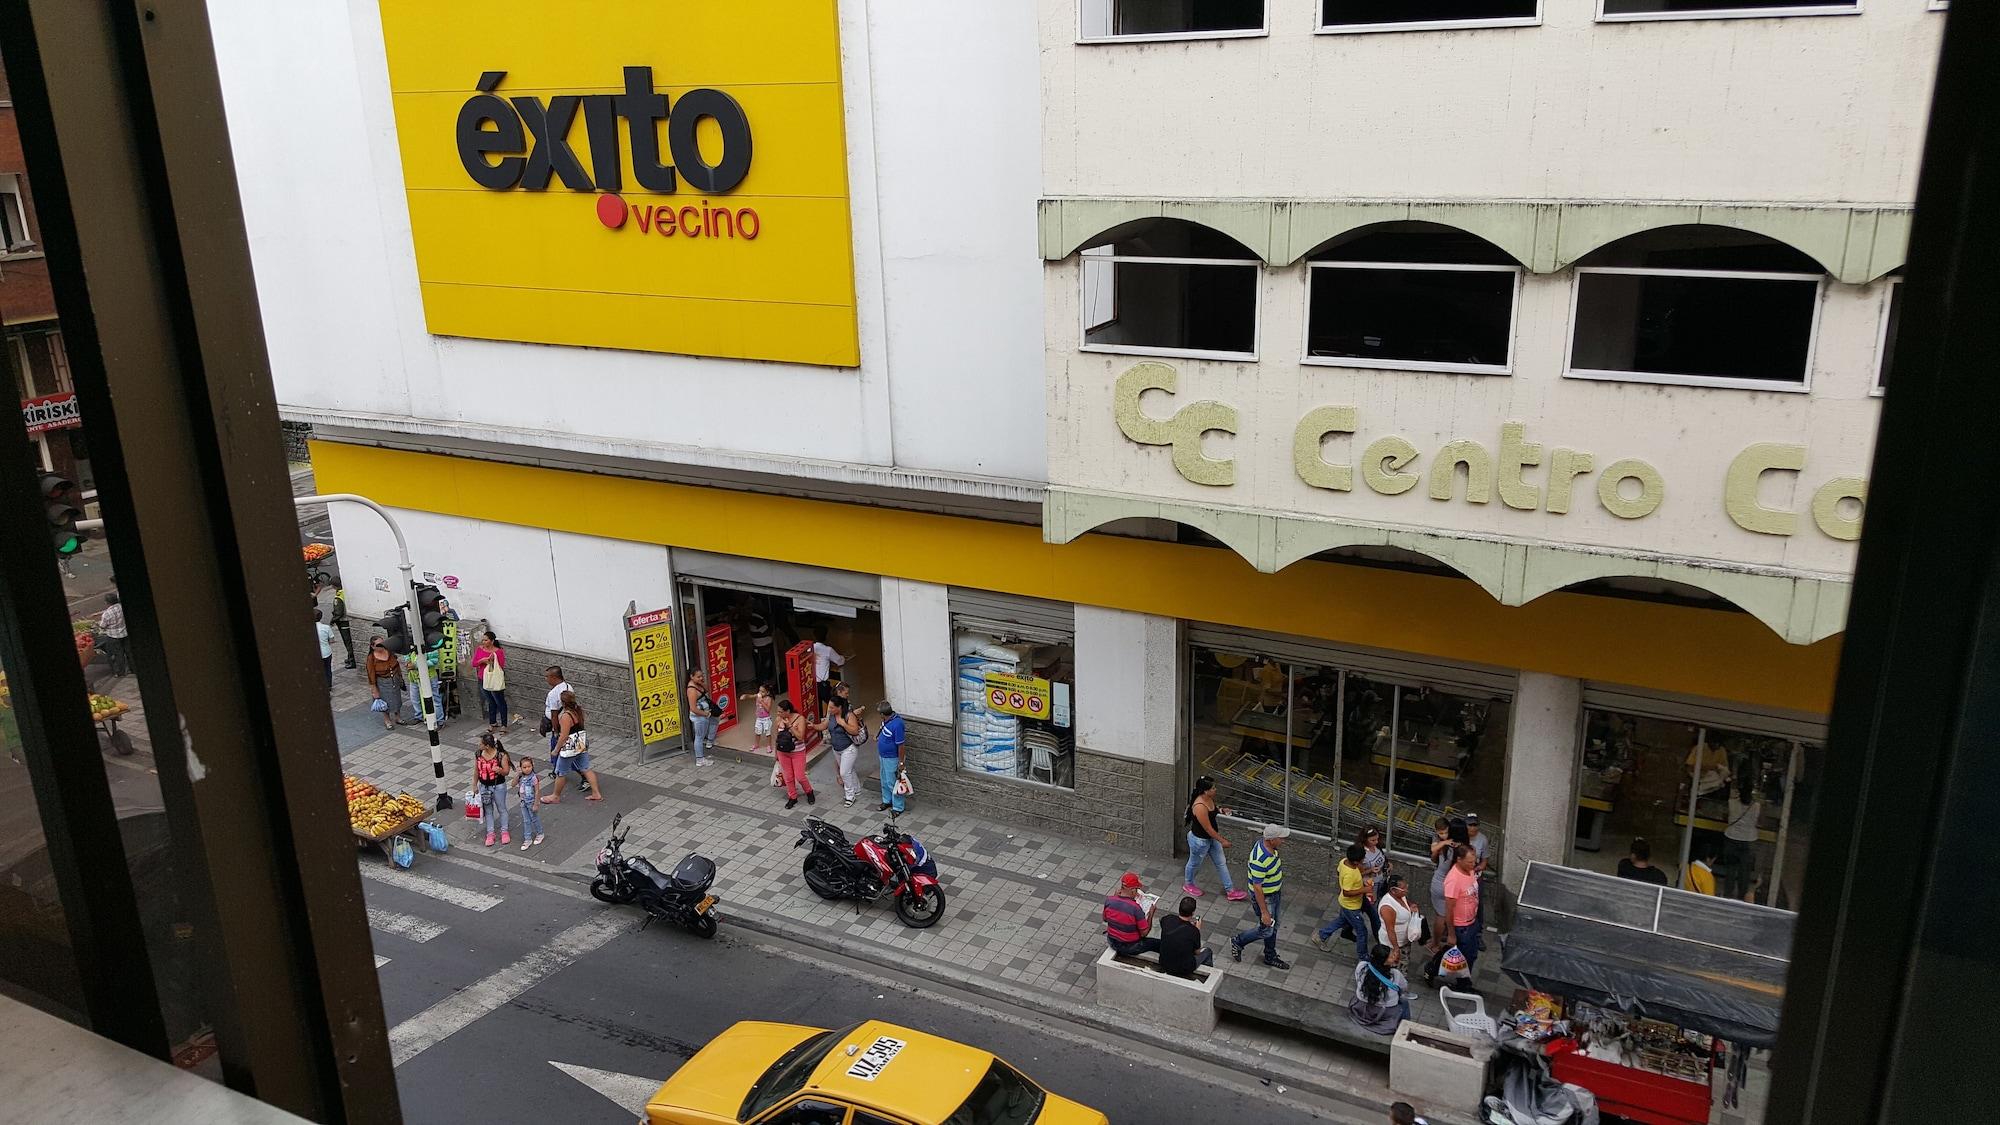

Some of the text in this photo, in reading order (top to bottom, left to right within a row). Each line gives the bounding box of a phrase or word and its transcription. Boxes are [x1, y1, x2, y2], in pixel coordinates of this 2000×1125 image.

[456, 66, 753, 194] éxito
[631, 200, 760, 240] vecino
[1293, 406, 1665, 520] Centro
[632, 614, 659, 626] oferta
